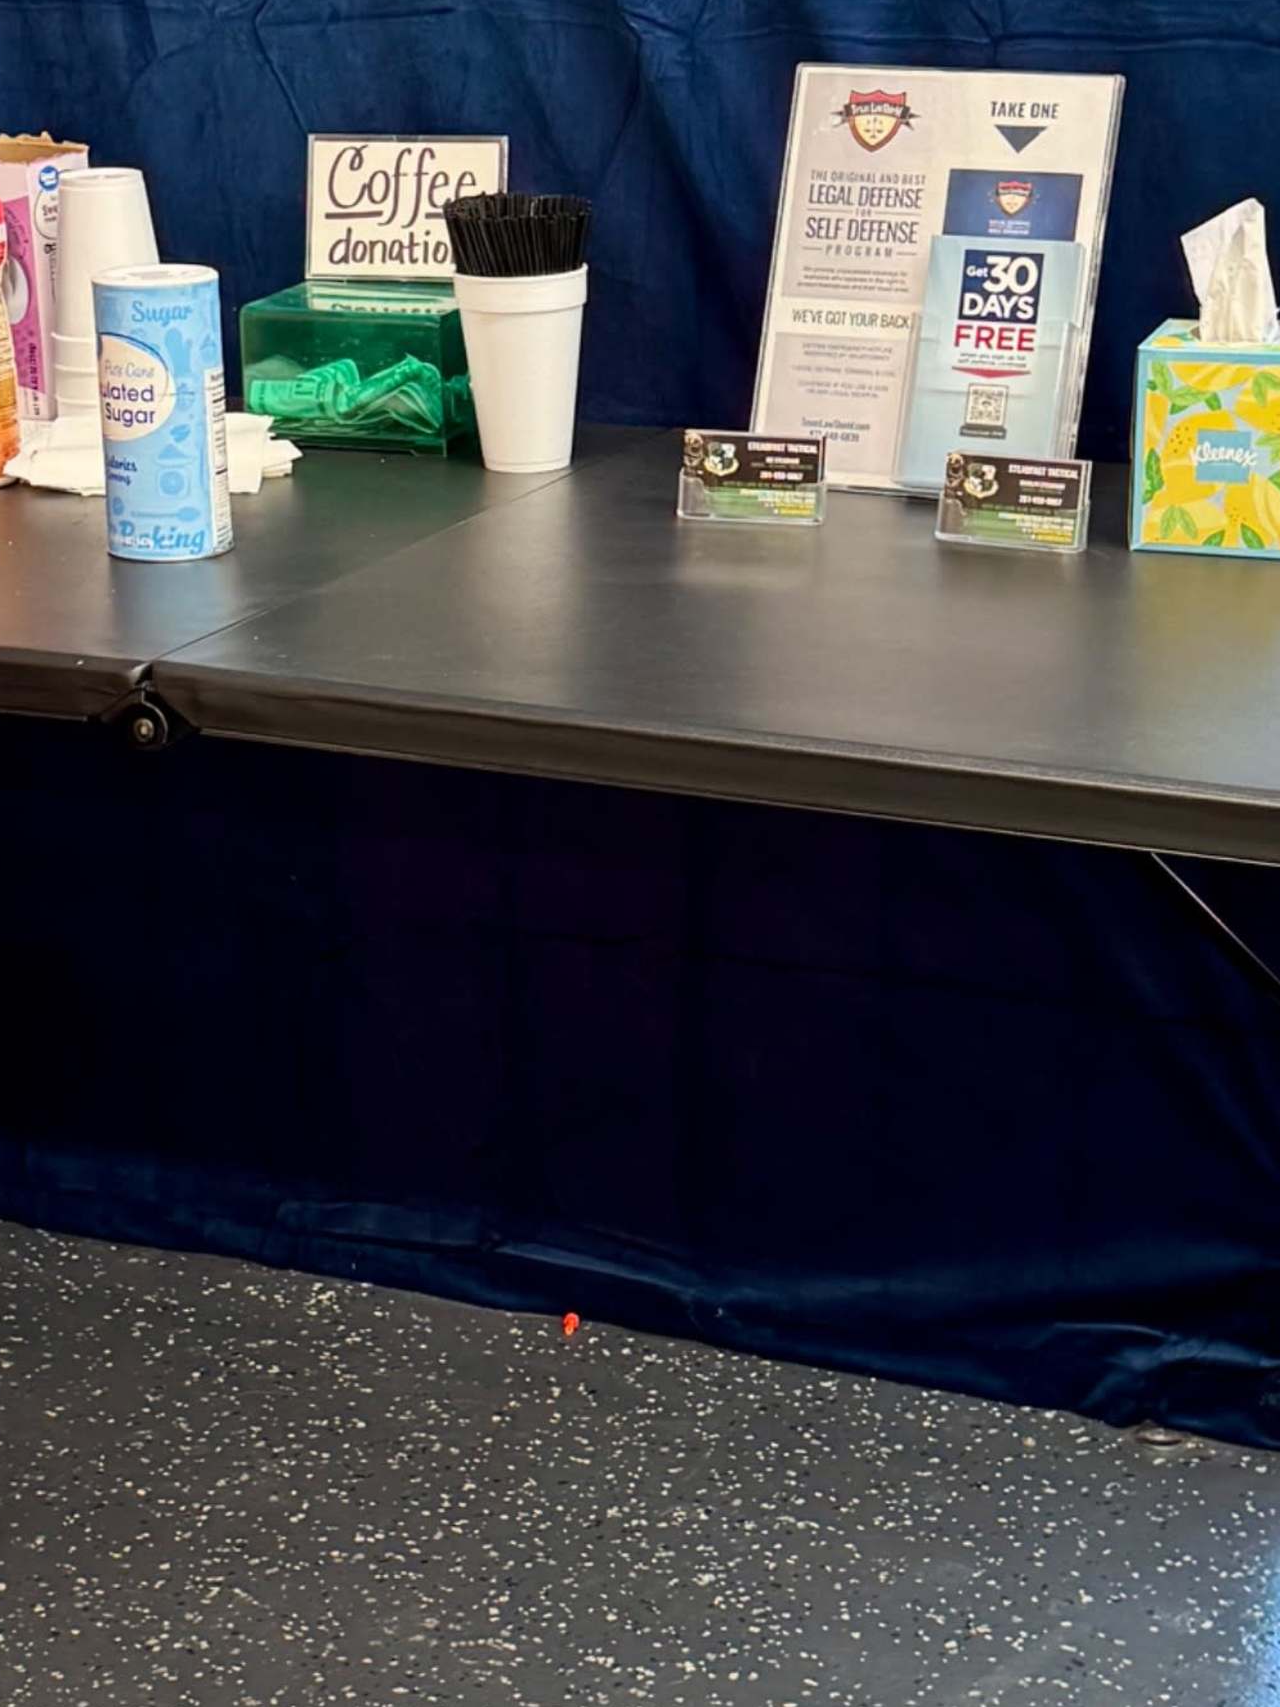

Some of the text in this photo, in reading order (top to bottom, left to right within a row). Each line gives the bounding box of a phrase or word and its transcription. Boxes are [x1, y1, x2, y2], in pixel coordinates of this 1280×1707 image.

[989, 100, 1060, 120] TAKE ONE
[328, 143, 478, 229] Coffee
[810, 169, 927, 186] THE ORIGINAL AND BEST
[808, 183, 925, 209] LEGAL DEFENSE
[805, 216, 920, 244] SELF DEFENSE
[328, 226, 456, 265] donatio
[824, 244, 894, 258] PROGRAM
[966, 254, 1039, 295] Get 30
[130, 300, 193, 327] Sugar
[792, 309, 824, 325] WE'VE
[825, 311, 847, 326] GOT
[849, 311, 879, 327] YOUR
[962, 292, 1036, 320] DAYS
[953, 323, 1038, 353] FREE
[104, 402, 156, 428] Sugar
[1189, 440, 1257, 467] Kleenex
